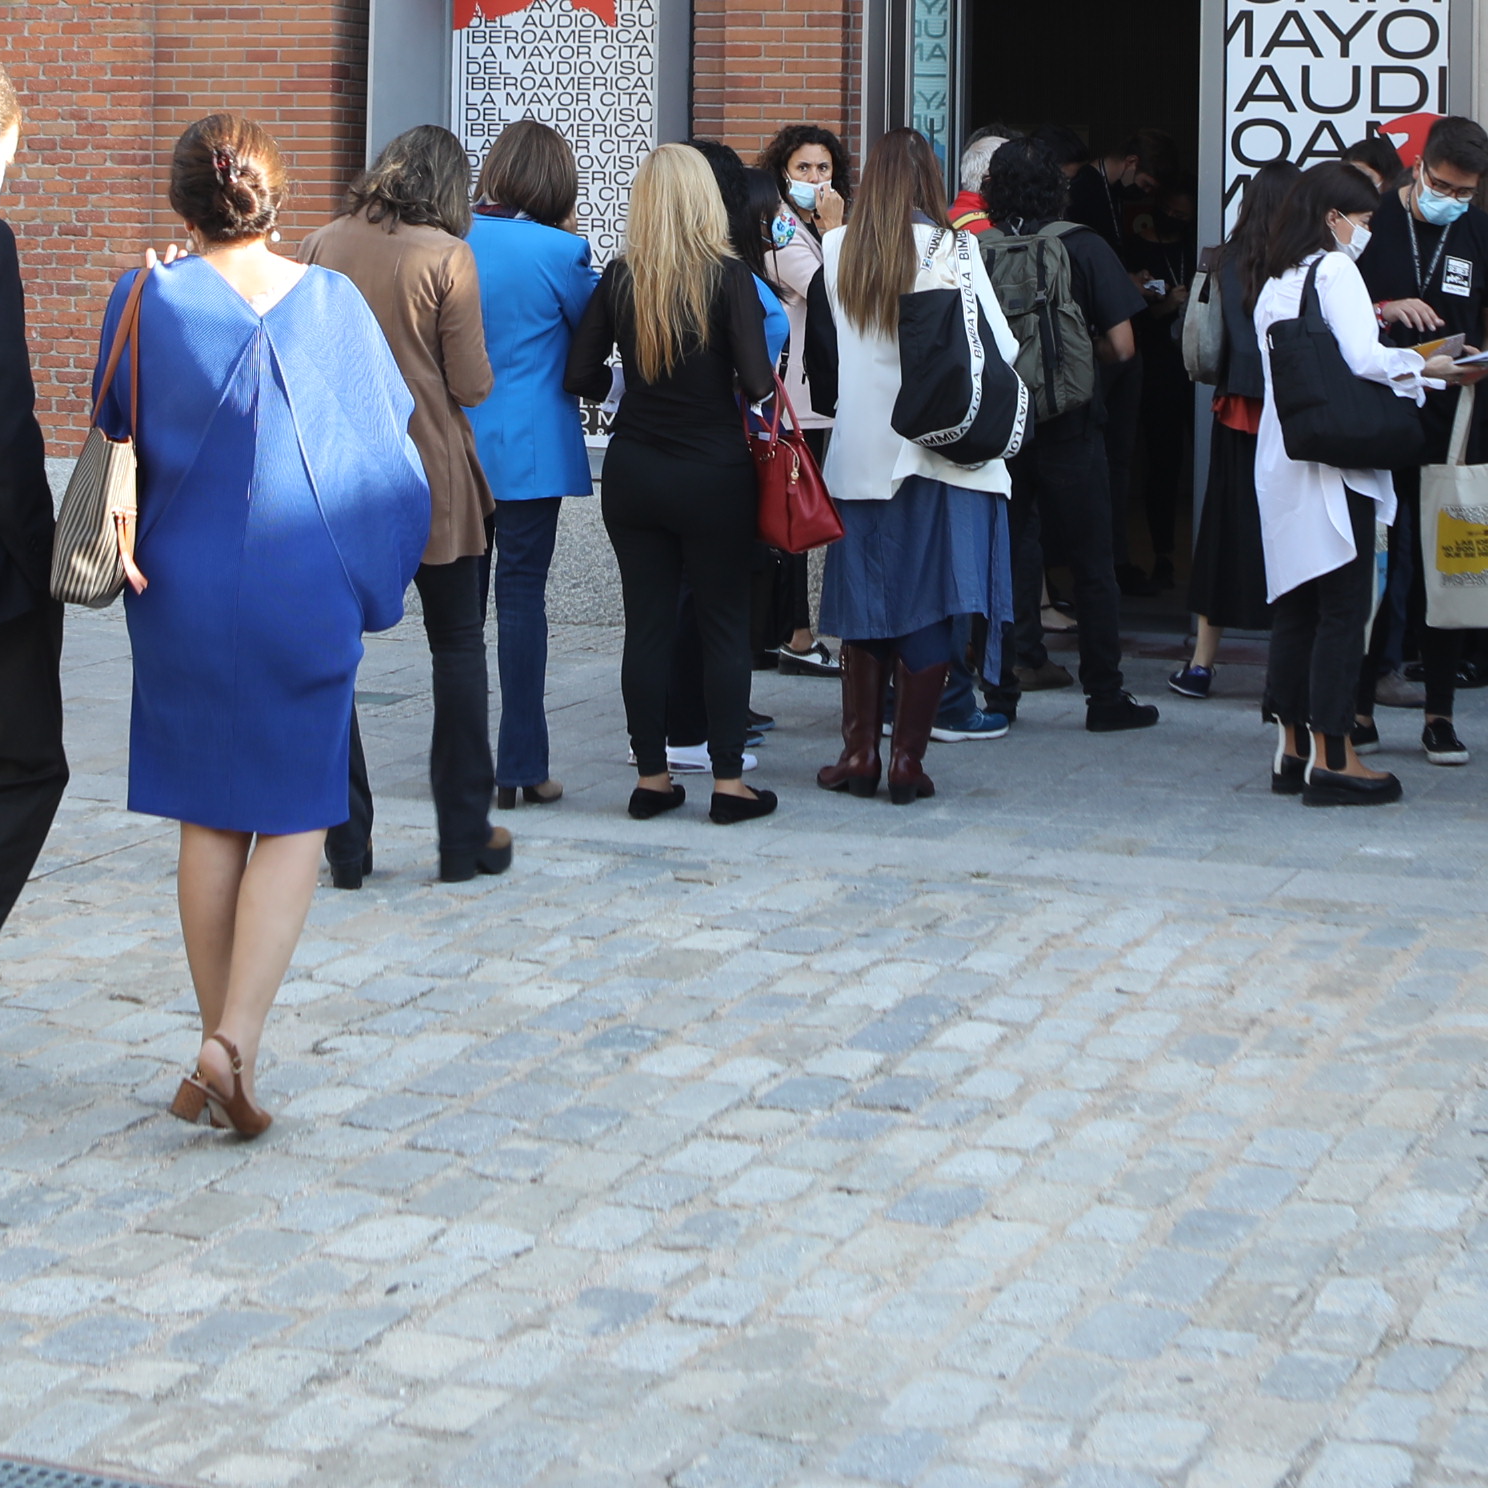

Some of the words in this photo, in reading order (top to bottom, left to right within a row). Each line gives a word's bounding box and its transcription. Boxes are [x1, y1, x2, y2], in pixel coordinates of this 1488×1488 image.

[466, 45, 497, 59] LA
[507, 45, 592, 60] MAYOR
[601, 45, 653, 59] CITA
[466, 61, 512, 75] DEL
[465, 92, 497, 106] LA
[506, 92, 591, 107] MAYOR
[600, 92, 653, 107] CITA
[465, 107, 511, 122] DEL
[599, 139, 651, 154] CITA
[962, 271, 974, 304] LOLA
